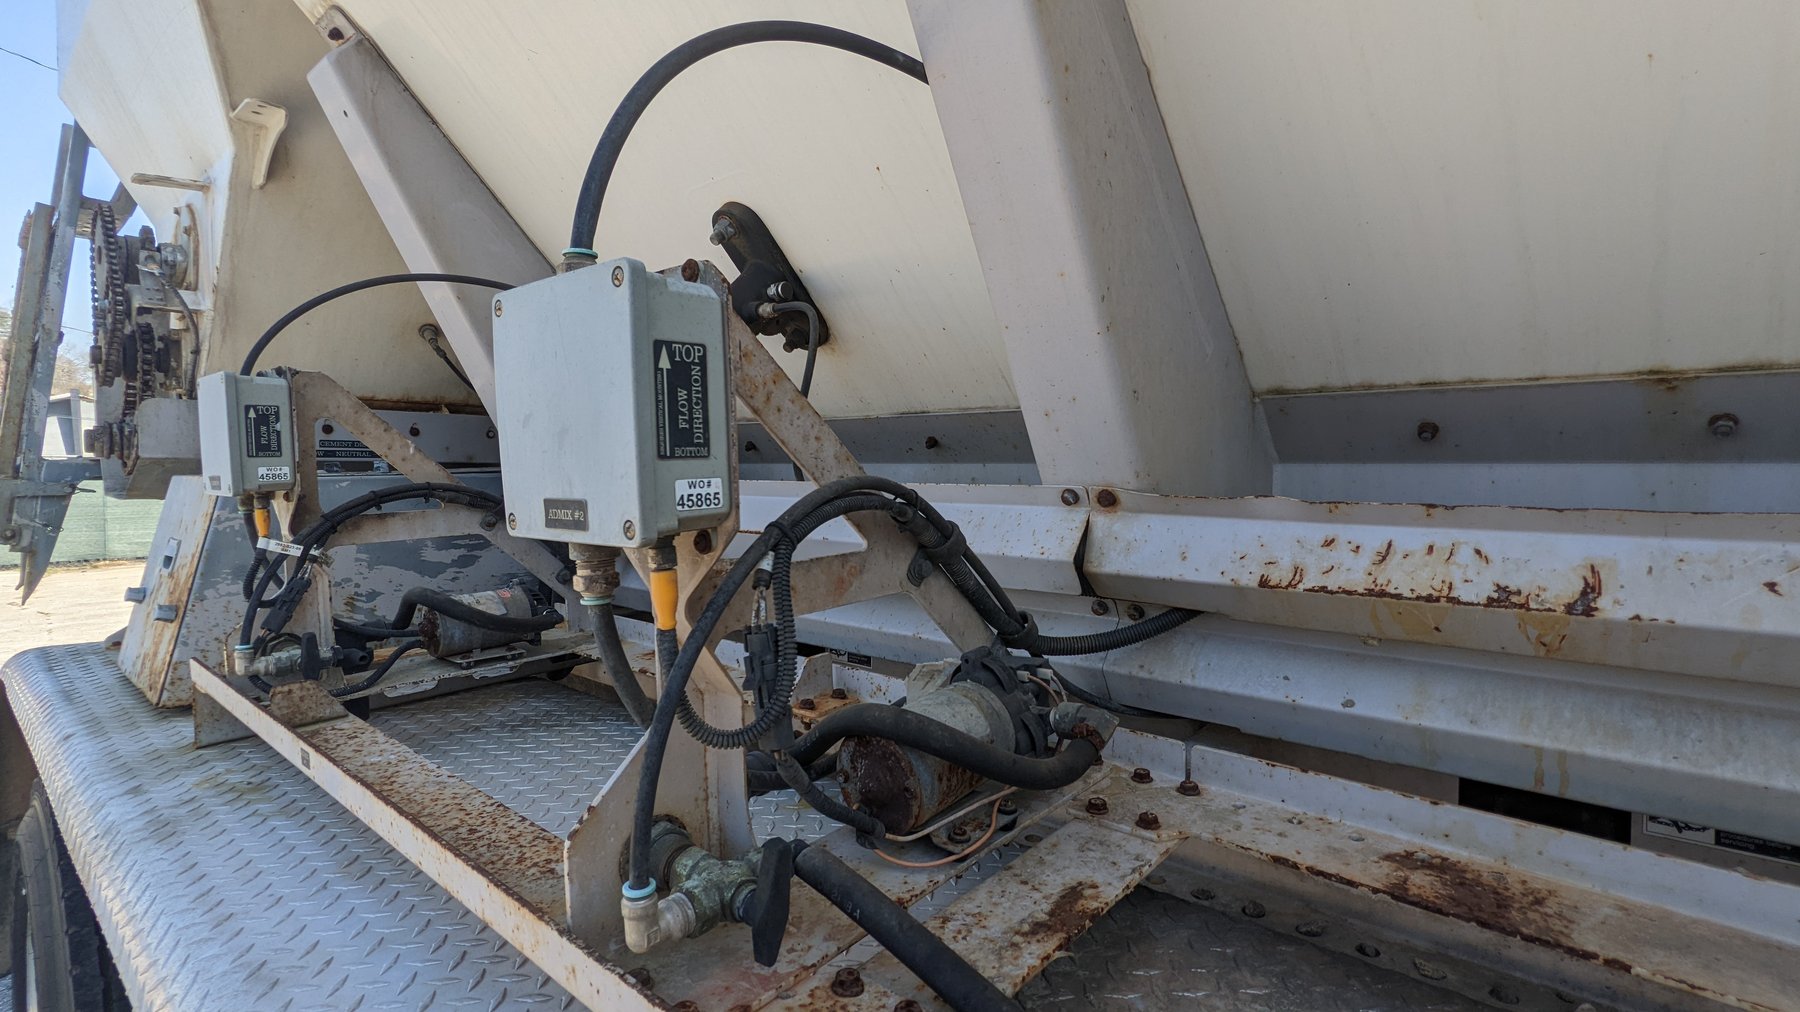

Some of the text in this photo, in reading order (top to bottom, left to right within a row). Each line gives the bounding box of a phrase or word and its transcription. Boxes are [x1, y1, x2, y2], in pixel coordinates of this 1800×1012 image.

[672, 344, 703, 363] TOP
[257, 406, 278, 415] TOP
[677, 387, 689, 429] FLOW
[691, 365, 704, 443] DIRECTION
[260, 425, 268, 444] FLOW
[269, 415, 278, 450] DIRECTION
[674, 447, 709, 457] BOTTOM
[259, 473, 289, 481] 45865
[687, 480, 712, 490] WO#
[676, 492, 721, 509] 45865
[548, 509, 585, 521] ADMIX #2
